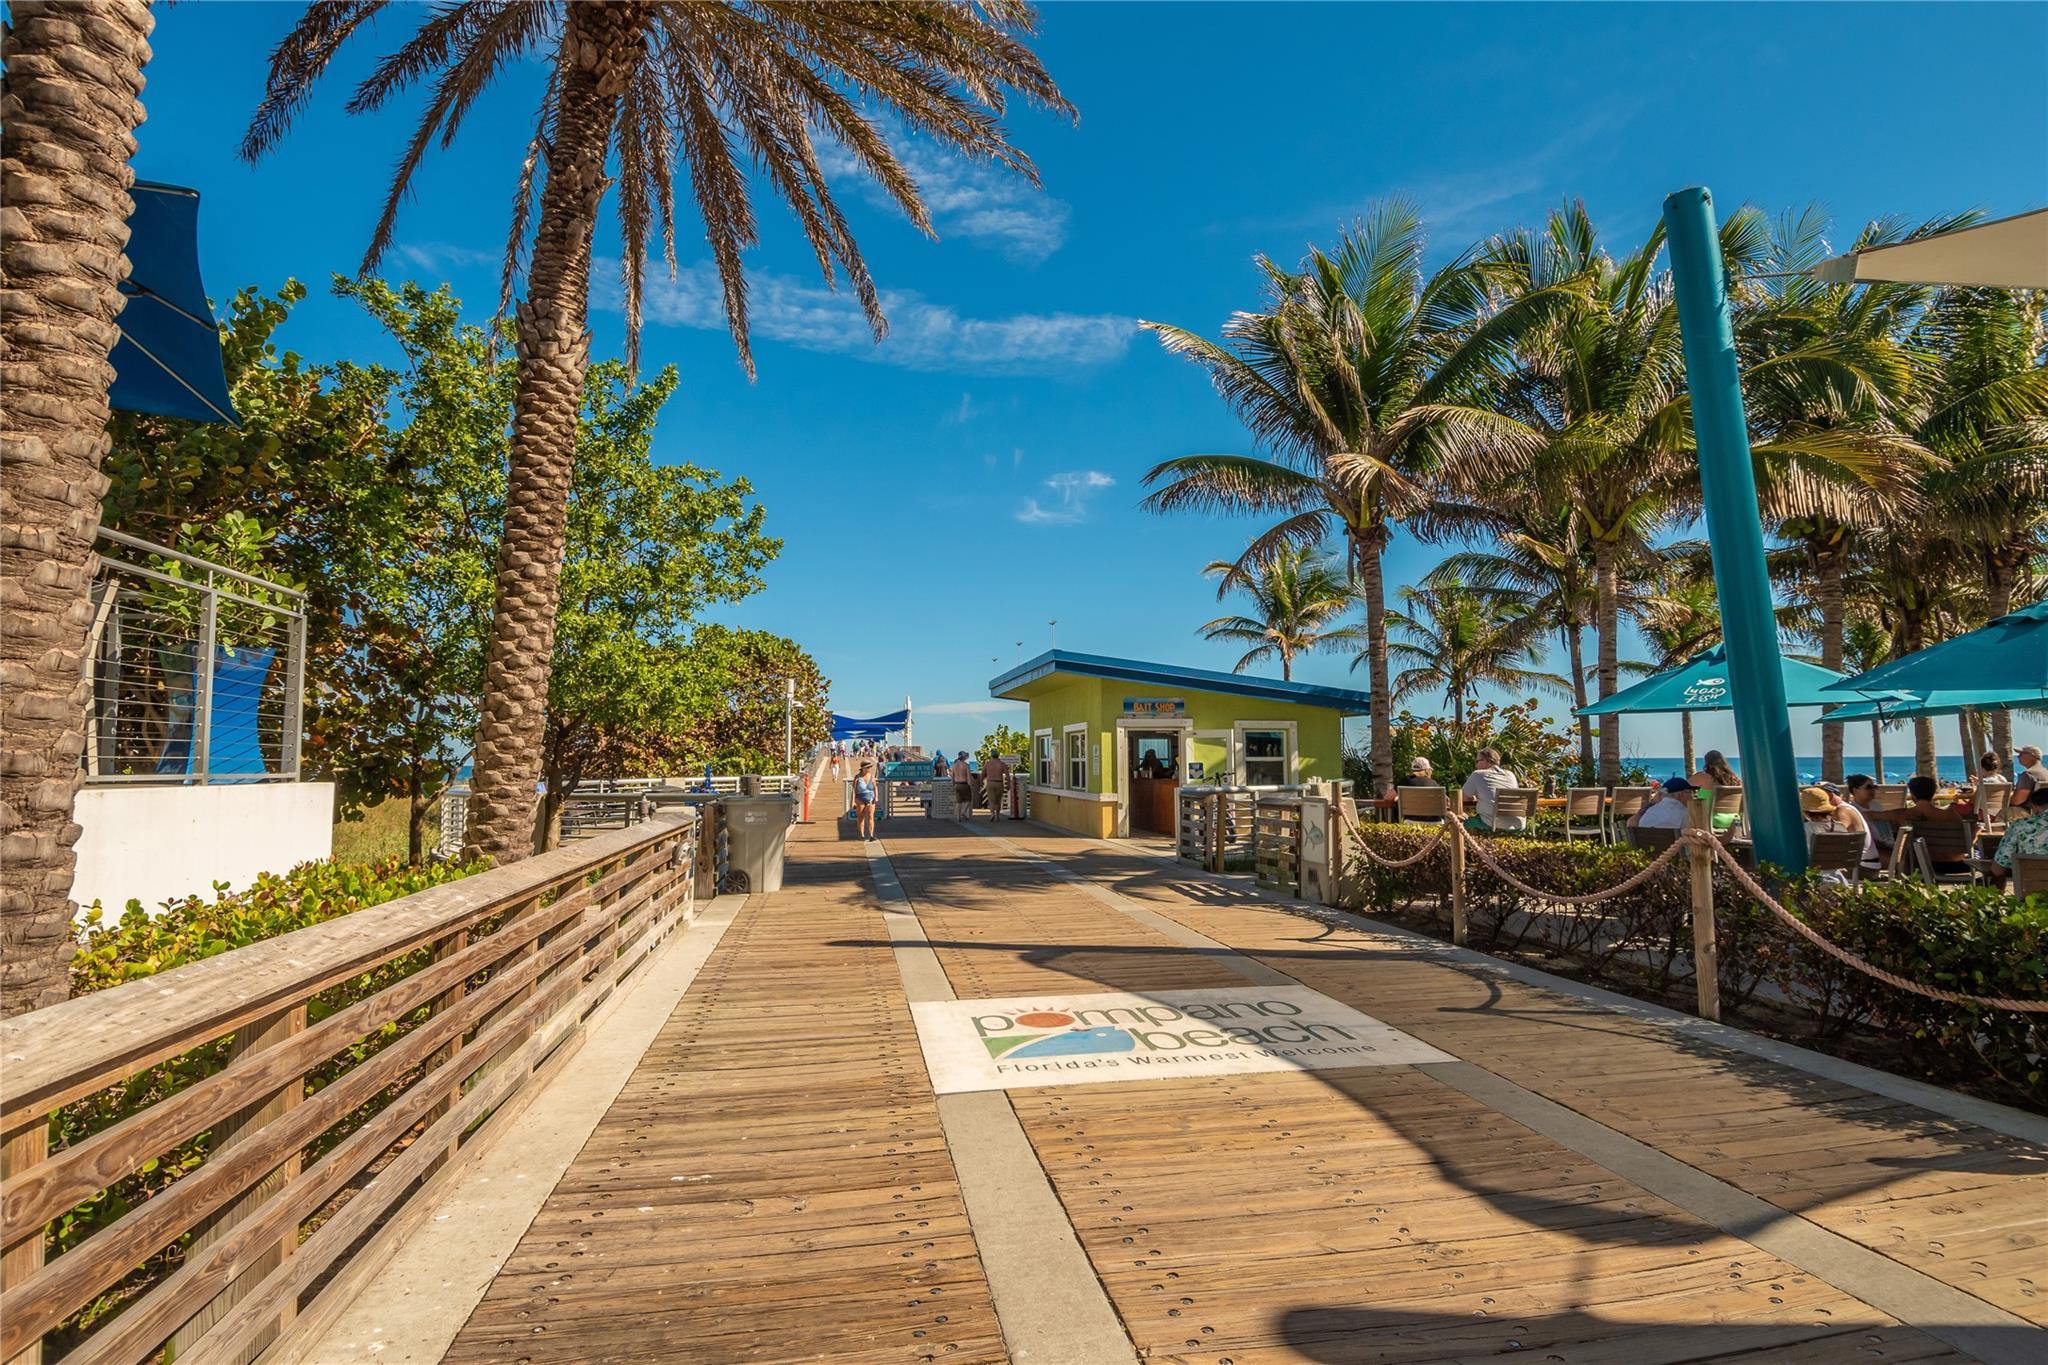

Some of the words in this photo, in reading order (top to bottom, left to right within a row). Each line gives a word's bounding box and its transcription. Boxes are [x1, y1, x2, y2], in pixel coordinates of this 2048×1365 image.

[1134, 703, 1152, 713] BAIT
[1155, 703, 1175, 712] SHOP
[970, 1000, 1302, 1037] pompano
[1128, 1018, 1358, 1050] beach
[997, 1058, 1120, 1074] Florida's
[1127, 1051, 1251, 1065] Warmest
[1254, 1044, 1377, 1058] Welcome
